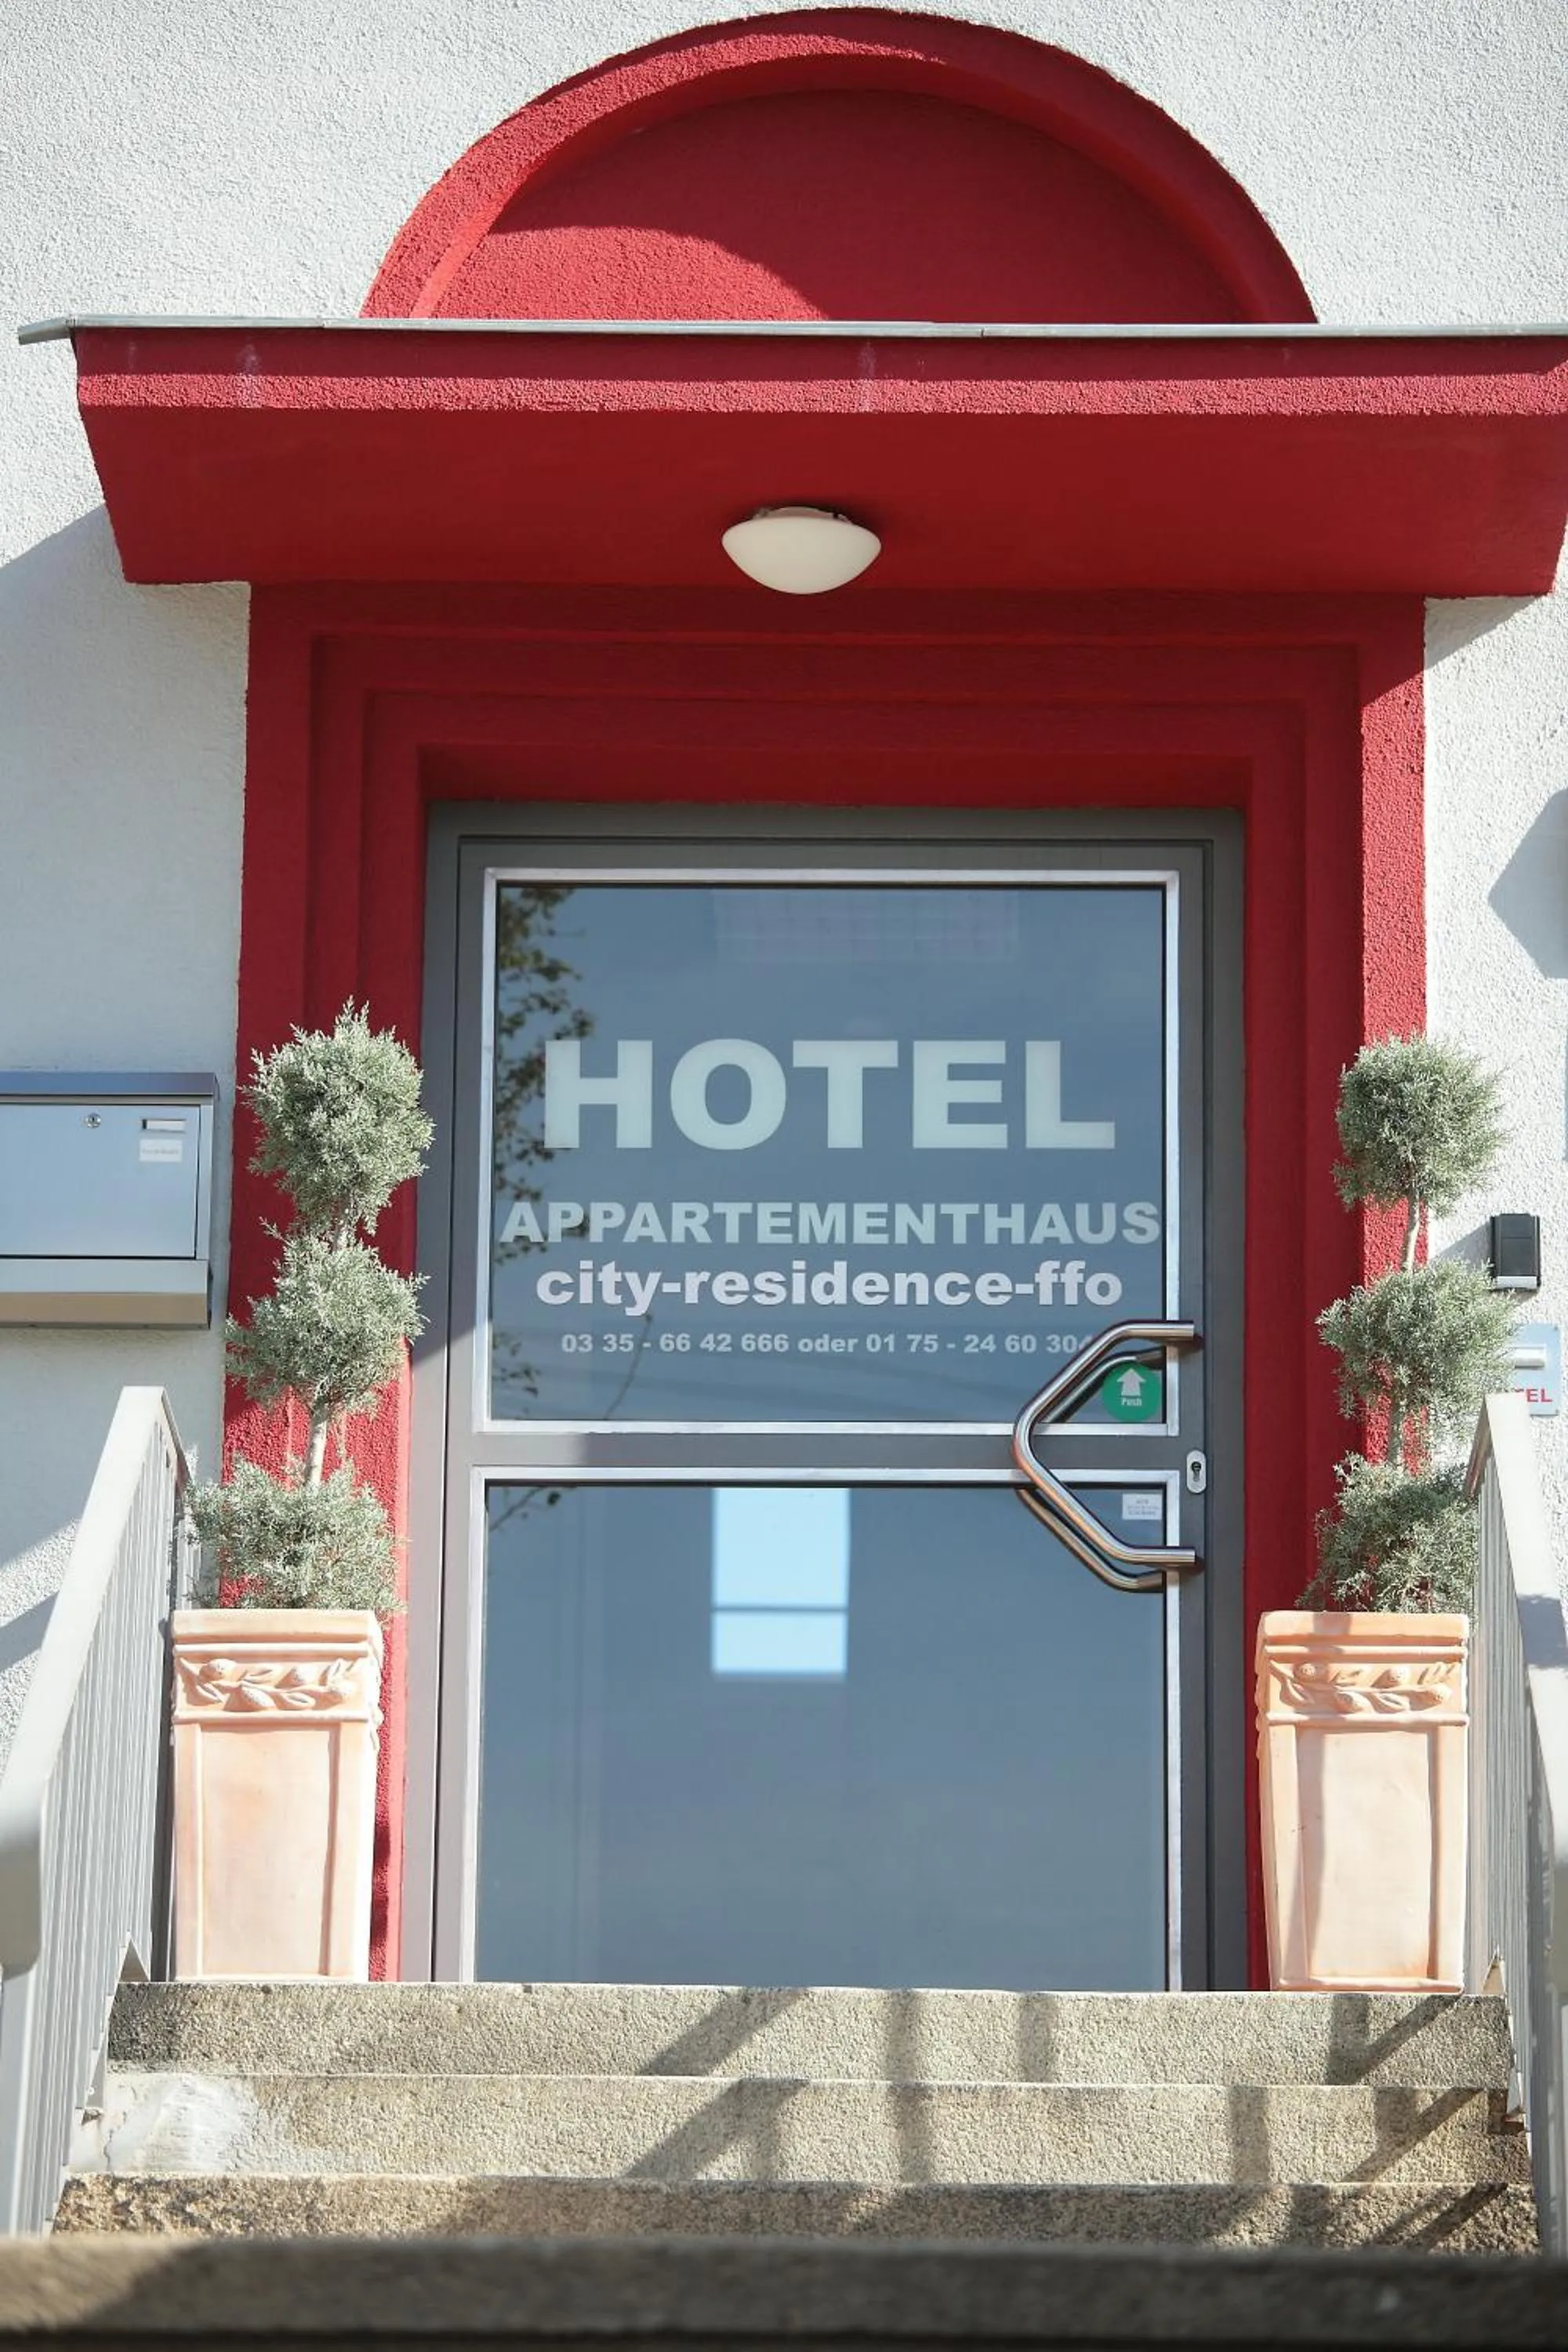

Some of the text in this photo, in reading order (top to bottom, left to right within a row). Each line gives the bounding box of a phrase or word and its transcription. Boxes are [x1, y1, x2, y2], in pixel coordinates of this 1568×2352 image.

[543, 1039, 1116, 1150] HOTEL
[499, 1202, 1160, 1245] APPARTEMENTHAUS
[535, 1259, 1122, 1316] city-residence-ffo
[561, 1333, 593, 1353] 03
[602, 1333, 634, 1353] 35
[659, 1333, 691, 1353] 66
[699, 1333, 732, 1353] 42
[741, 1333, 789, 1353] 666
[797, 1333, 858, 1353] oder
[866, 1333, 895, 1353] 01
[906, 1333, 938, 1353] 75
[964, 1333, 996, 1353] 24
[1004, 1333, 1037, 1353] 60
